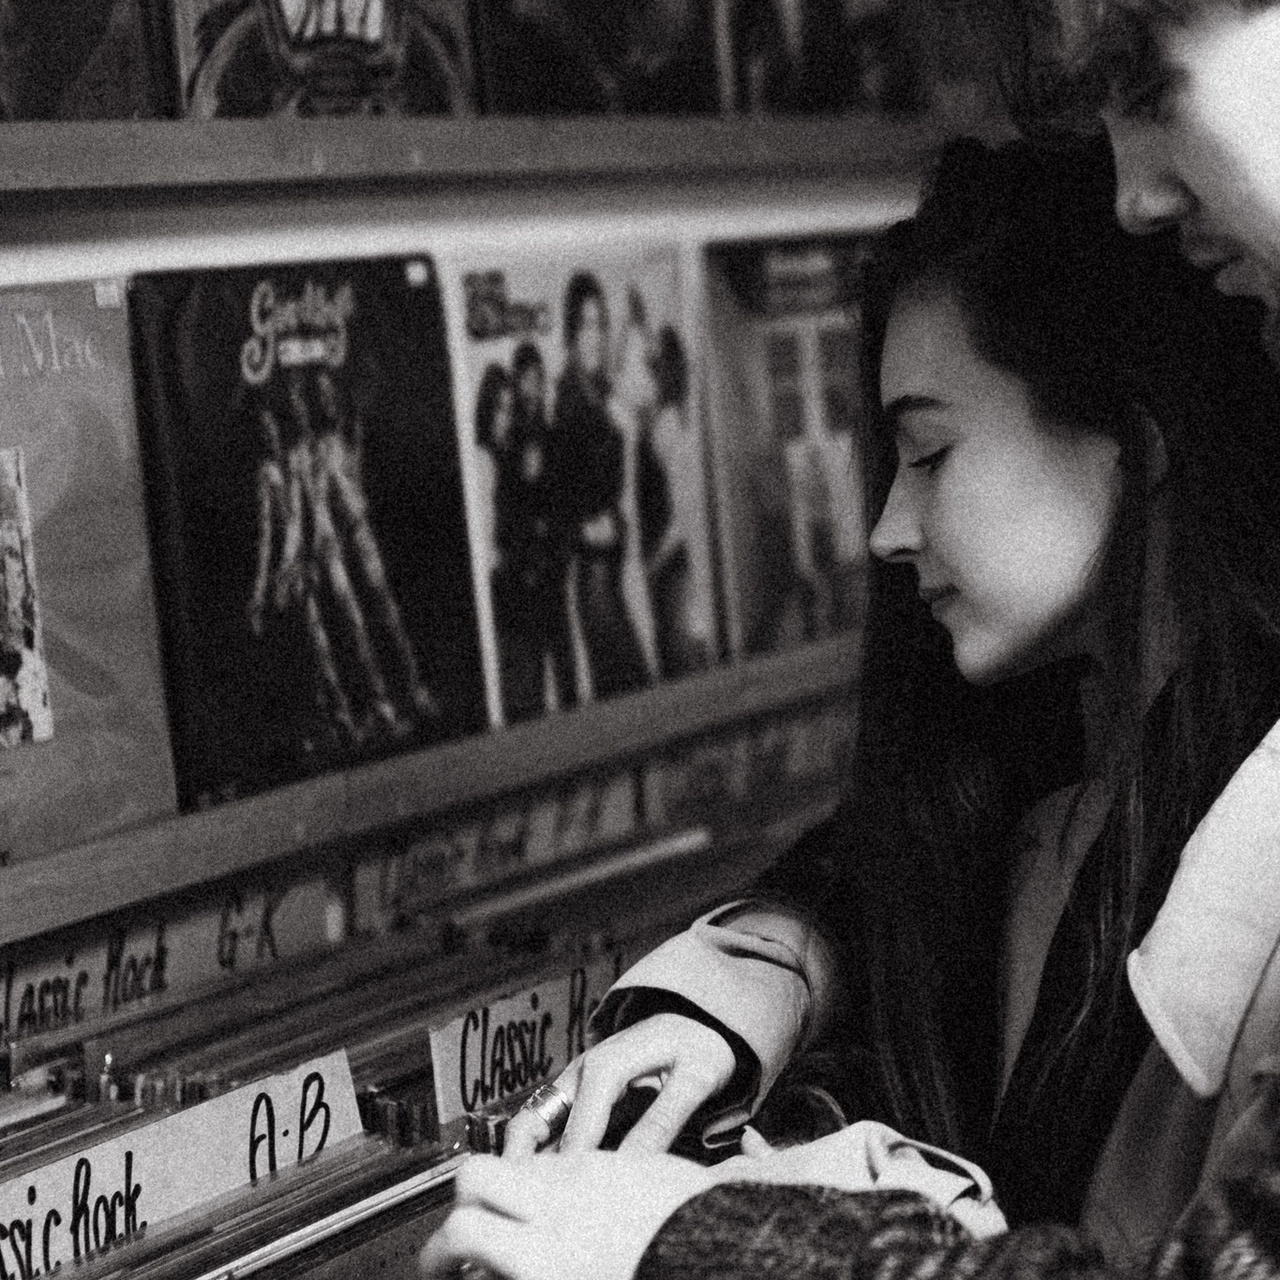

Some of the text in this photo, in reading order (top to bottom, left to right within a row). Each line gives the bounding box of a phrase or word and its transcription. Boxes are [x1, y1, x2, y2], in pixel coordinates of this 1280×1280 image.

[0, 950, 89, 1040] lassic
[102, 918, 169, 1014] Rock
[460, 990, 554, 1113] Classic
[70, 1150, 148, 1266] Rock
